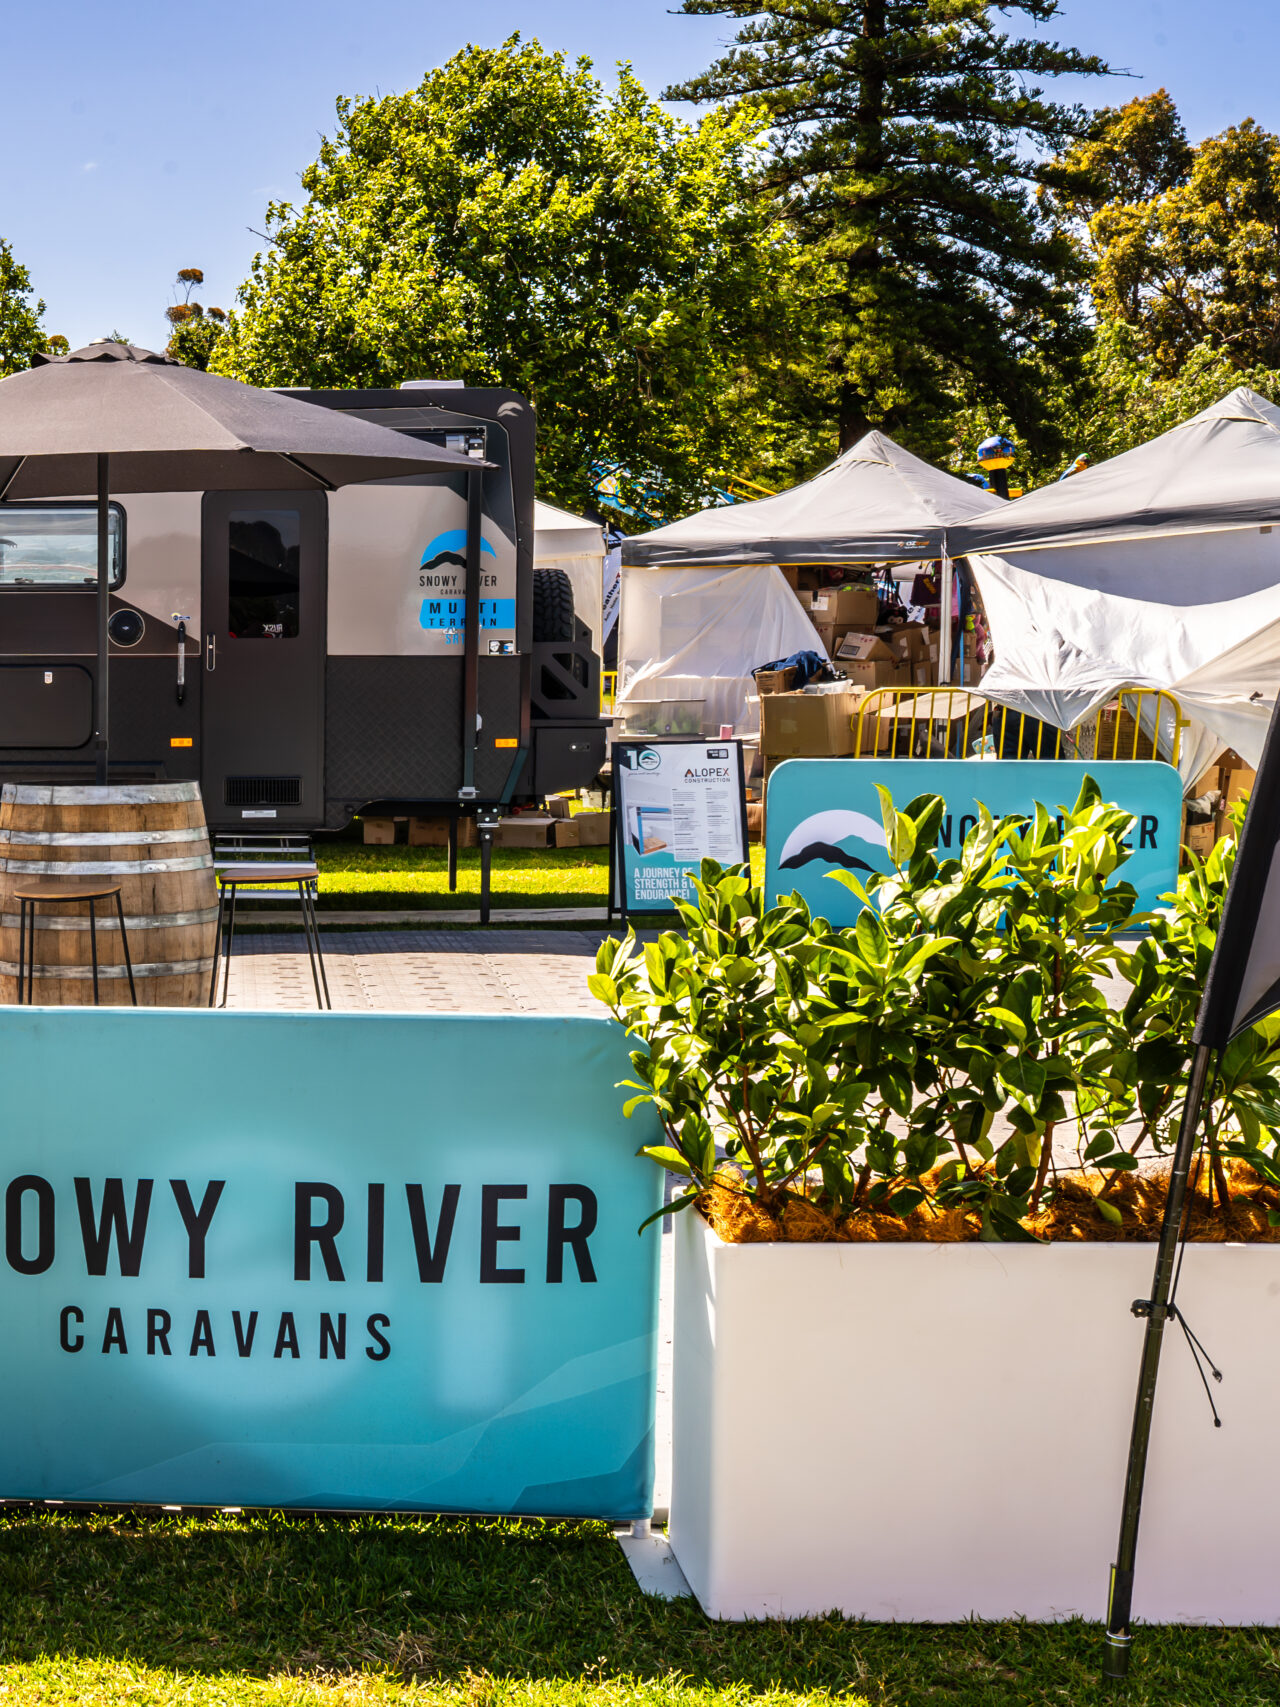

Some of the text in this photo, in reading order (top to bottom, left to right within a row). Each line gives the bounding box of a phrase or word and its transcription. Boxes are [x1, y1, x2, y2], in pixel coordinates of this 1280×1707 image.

[419, 575, 458, 587] SNOWY
[429, 602, 497, 614] MUTI
[429, 618, 497, 627] TERRIN
[684, 767, 730, 778] ALOPEX
[634, 868, 640, 878] A
[641, 867, 680, 878] JOURNEY
[634, 878, 679, 889] STRENGTH
[681, 878, 688, 889] &
[635, 889, 690, 900] ENDURANCE!
[294, 1181, 599, 1284] RIVER
[59, 1305, 392, 1362] CARAVANS
